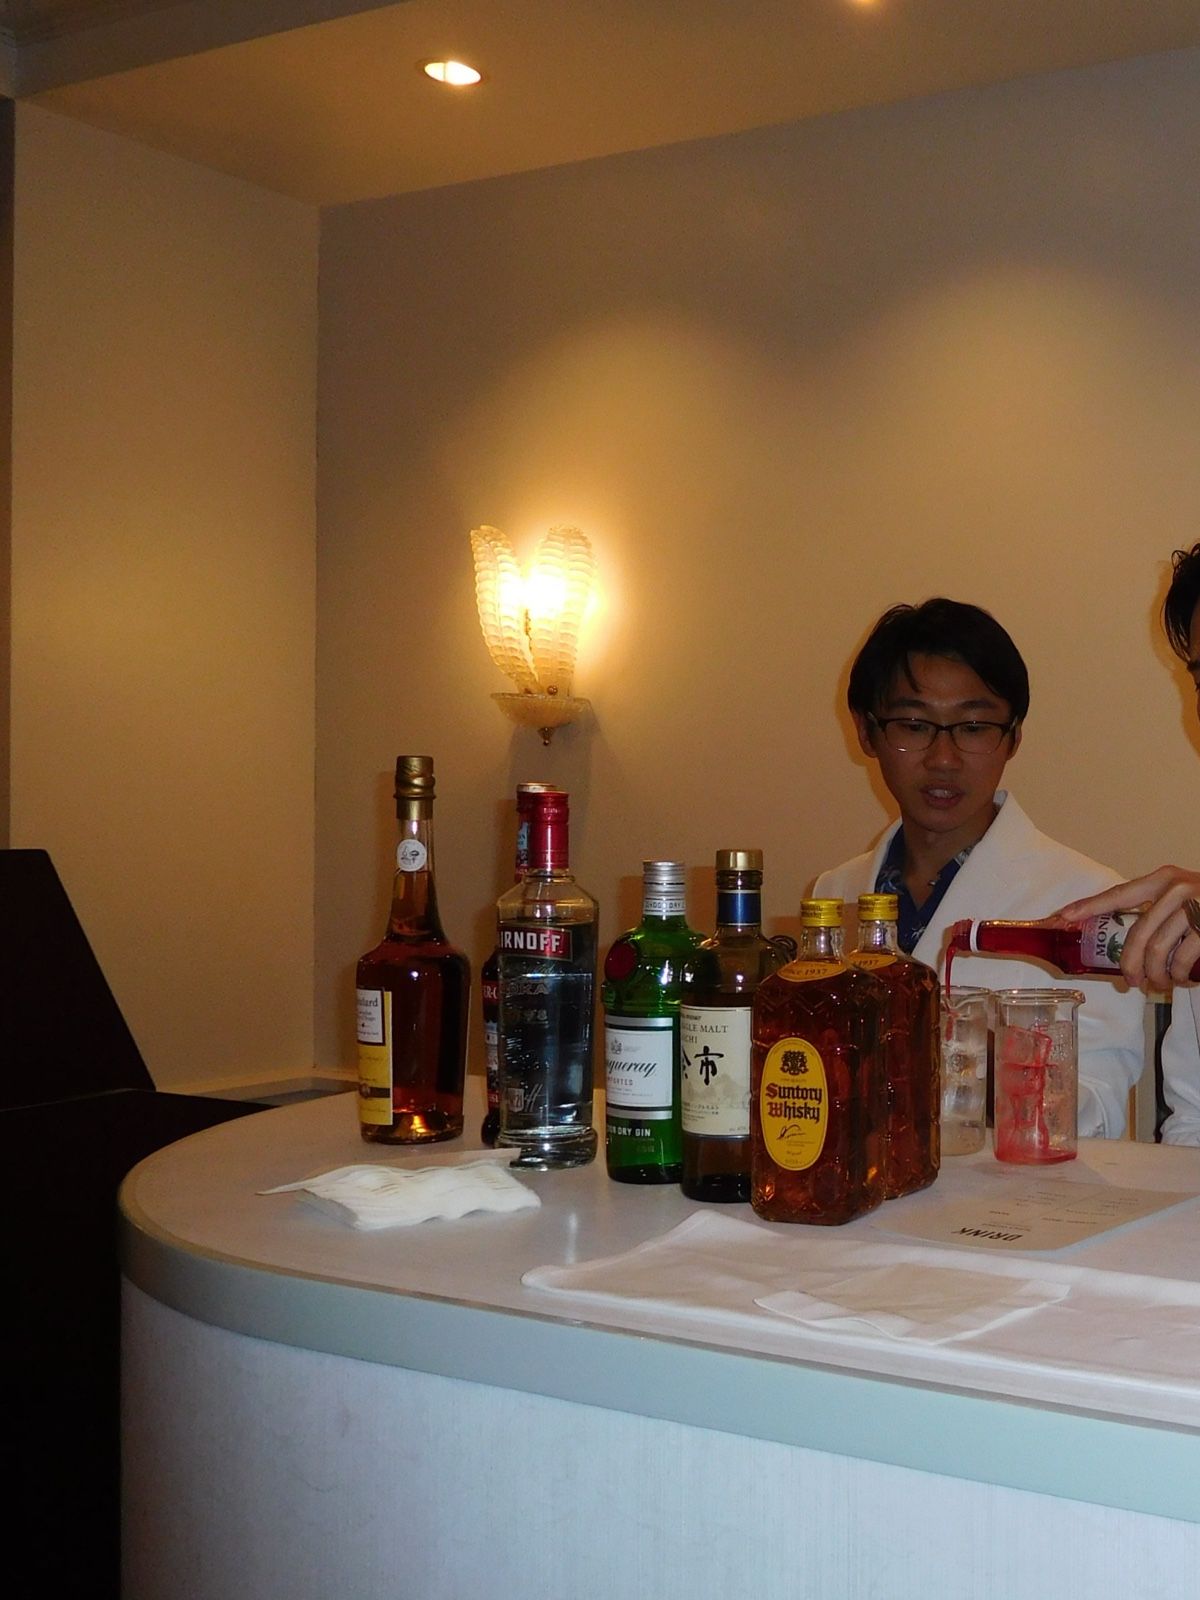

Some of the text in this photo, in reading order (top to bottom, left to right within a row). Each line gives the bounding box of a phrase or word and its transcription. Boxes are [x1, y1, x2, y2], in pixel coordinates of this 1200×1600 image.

[700, 1024, 728, 1033] MALT
[766, 1082, 823, 1104] Suntory
[767, 1100, 820, 1124] Whisky
[635, 1128, 651, 1137] GIN
[951, 1226, 1023, 1242] DRINK
